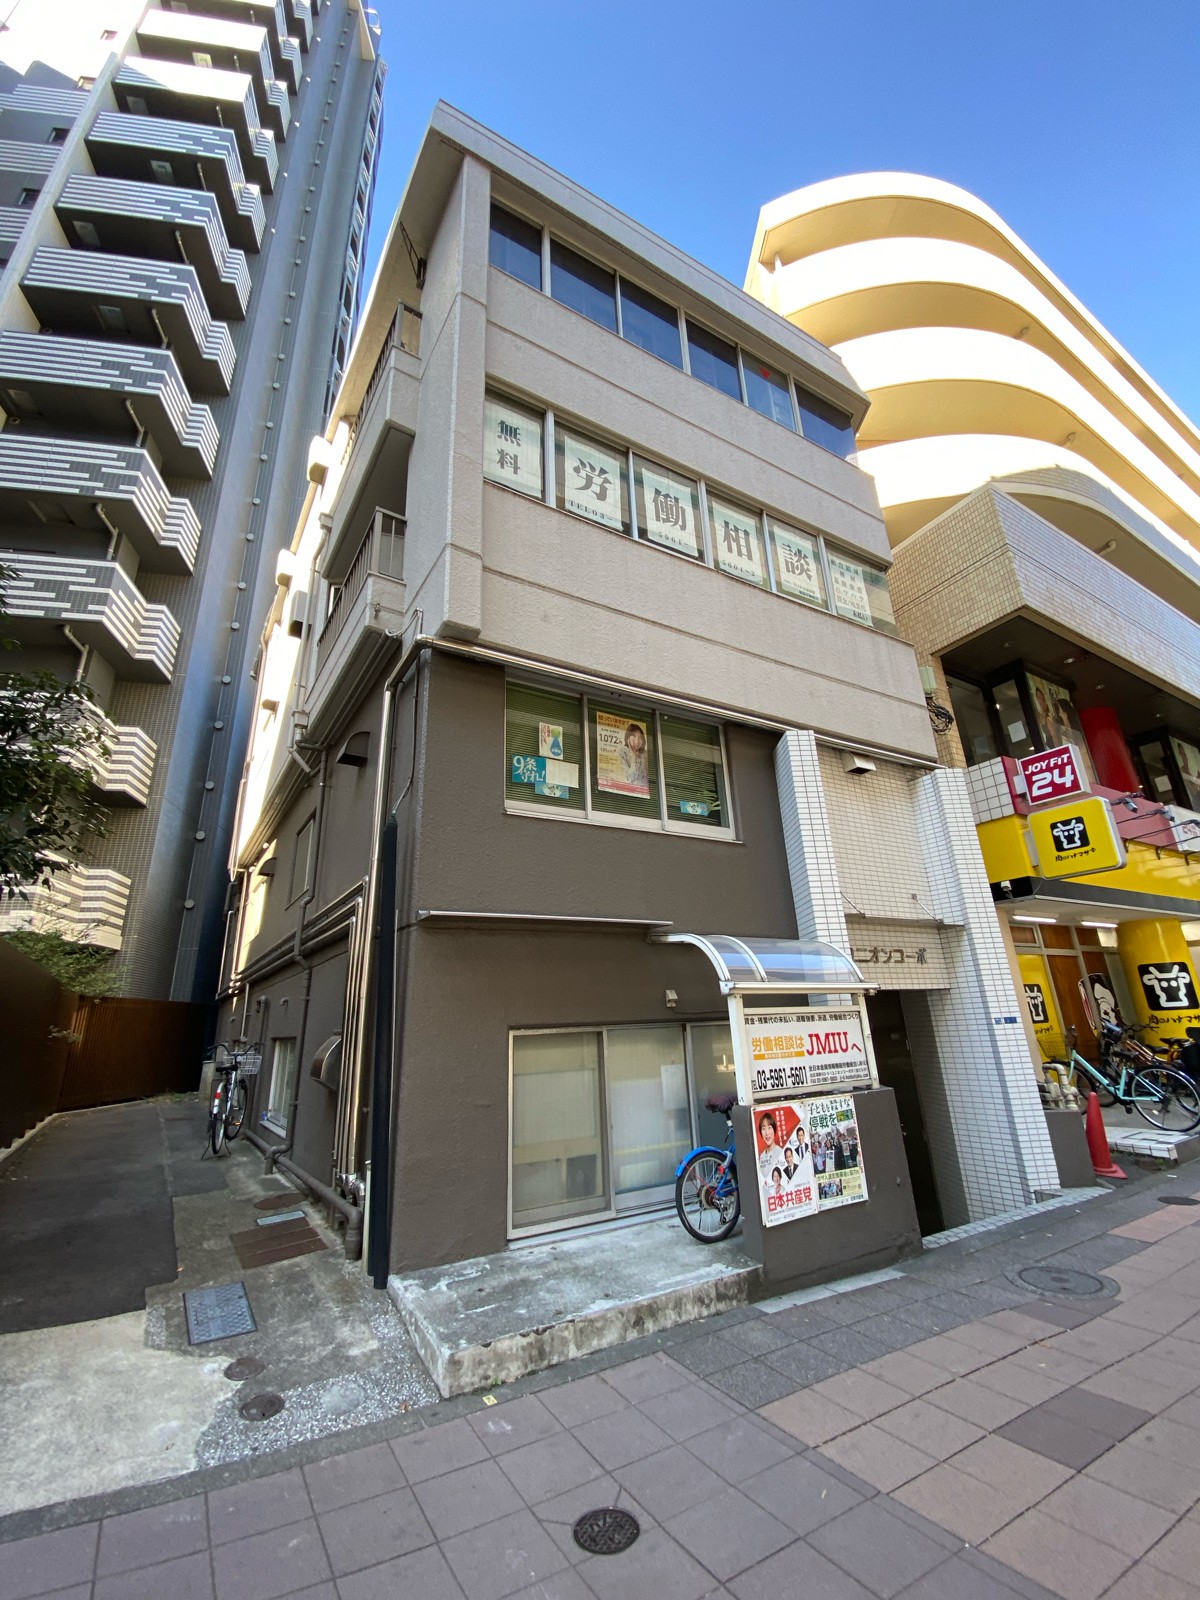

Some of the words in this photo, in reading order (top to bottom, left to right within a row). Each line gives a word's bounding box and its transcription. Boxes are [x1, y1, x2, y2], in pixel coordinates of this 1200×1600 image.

[497, 420, 521, 475] 無料
[513, 755, 538, 775] 9条
[1032, 765, 1074, 797] 24
[850, 946, 927, 965] ニオンコーポ
[757, 1066, 808, 1090] 03-5961-5601
[809, 1112, 837, 1132] 停戦を
[767, 1186, 812, 1213] 日本共産党
